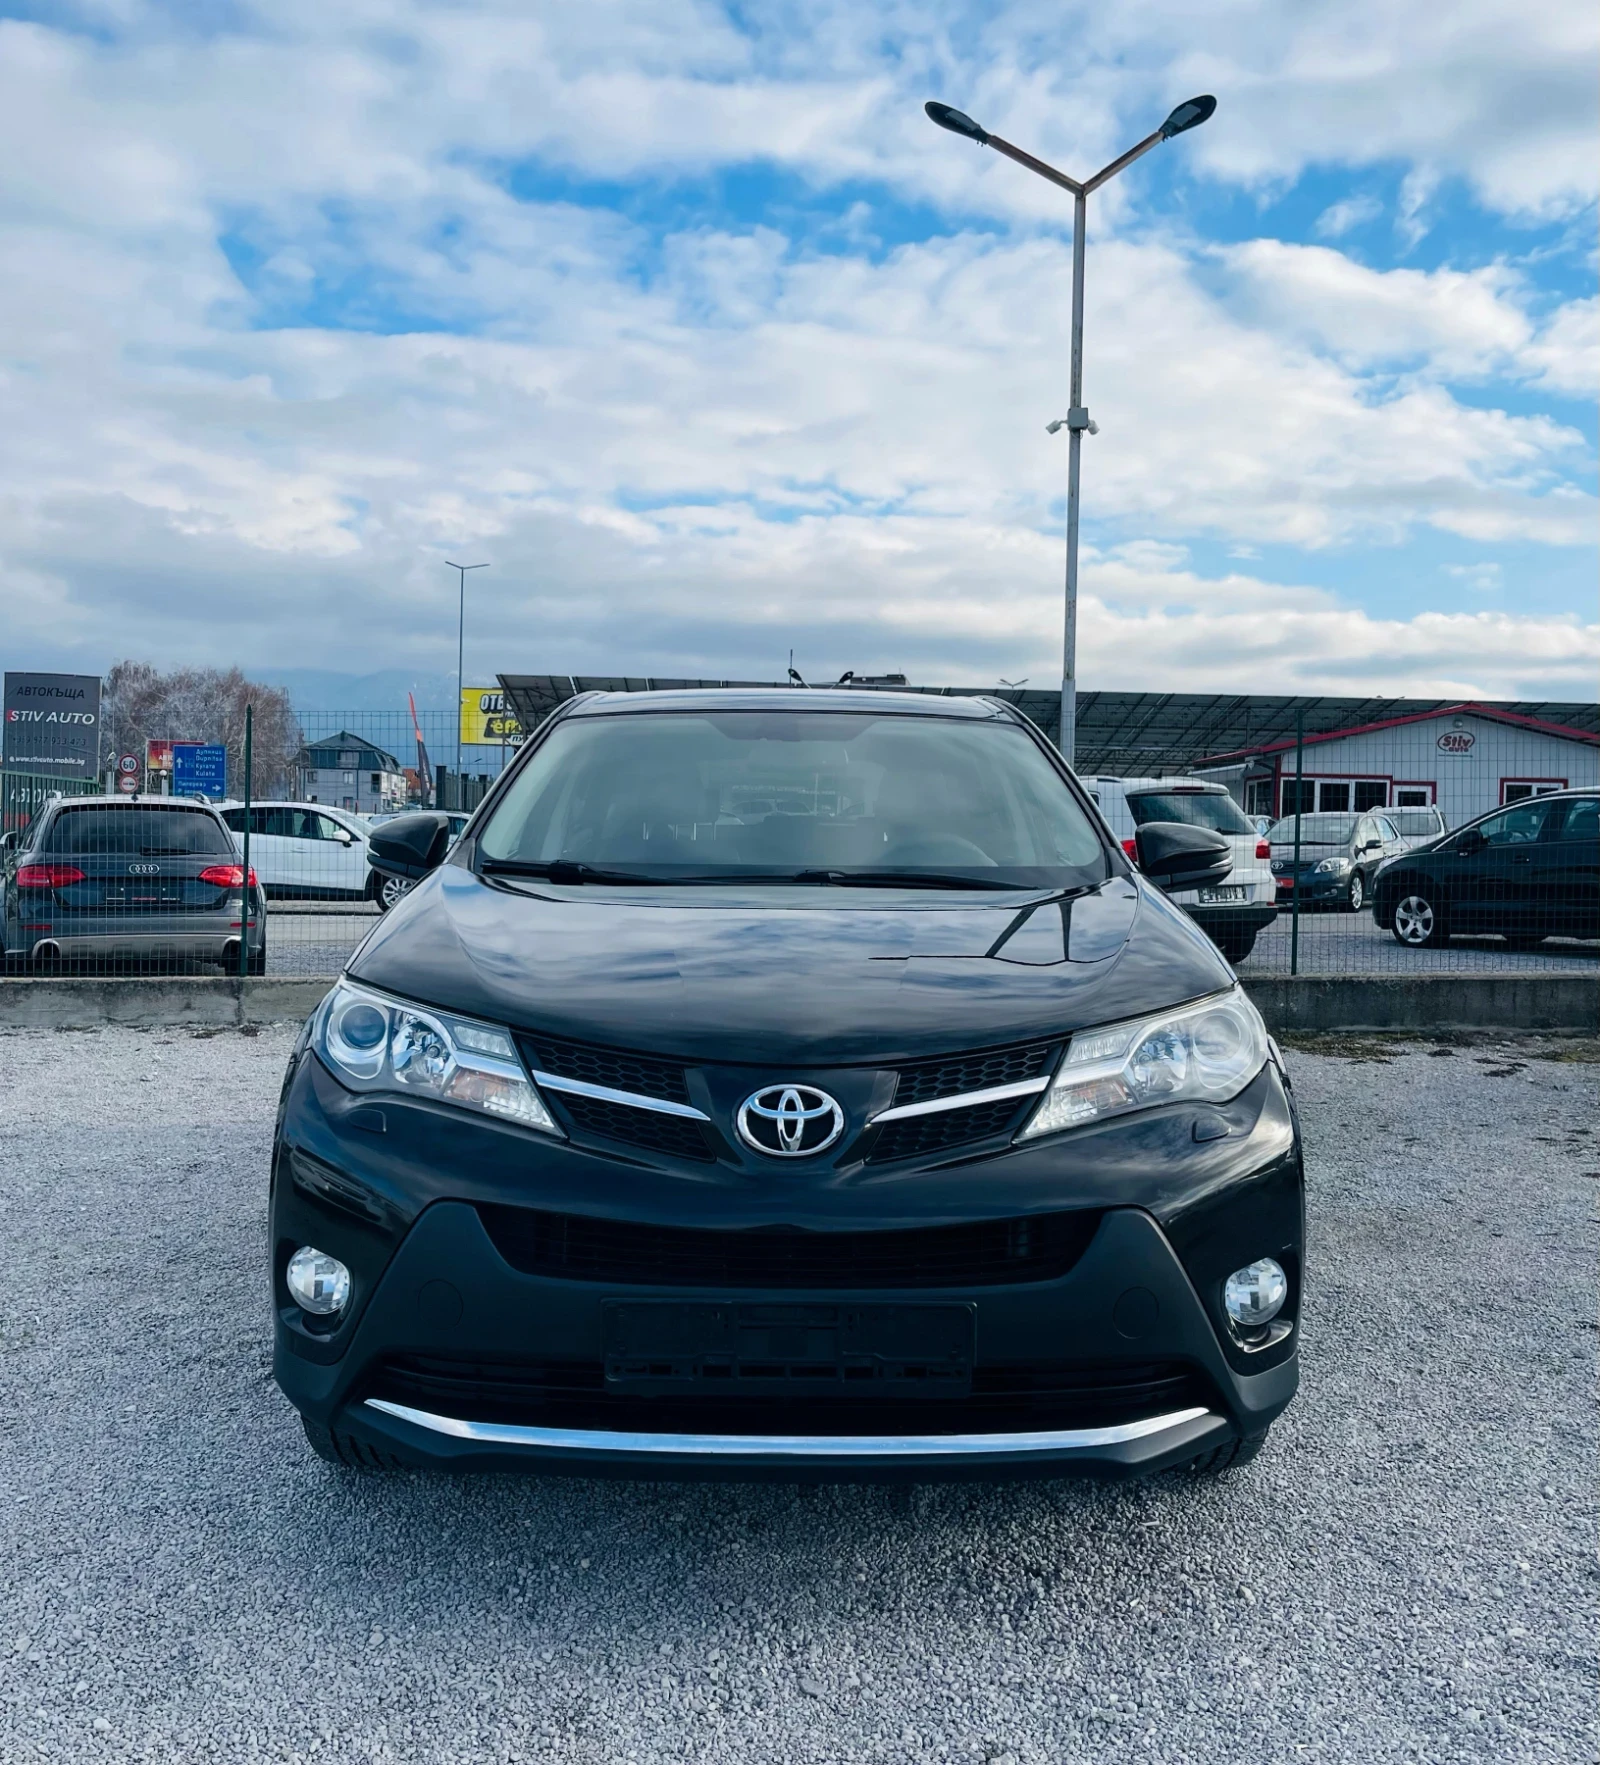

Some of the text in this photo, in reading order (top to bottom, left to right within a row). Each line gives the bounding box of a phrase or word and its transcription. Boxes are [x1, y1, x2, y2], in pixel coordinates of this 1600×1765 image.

[17, 686, 85, 700] АВТОКЪЩА
[10, 710, 95, 725] STIV AUTO
[1442, 735, 1471, 747] Stiv
[122, 759, 135, 770] 60
